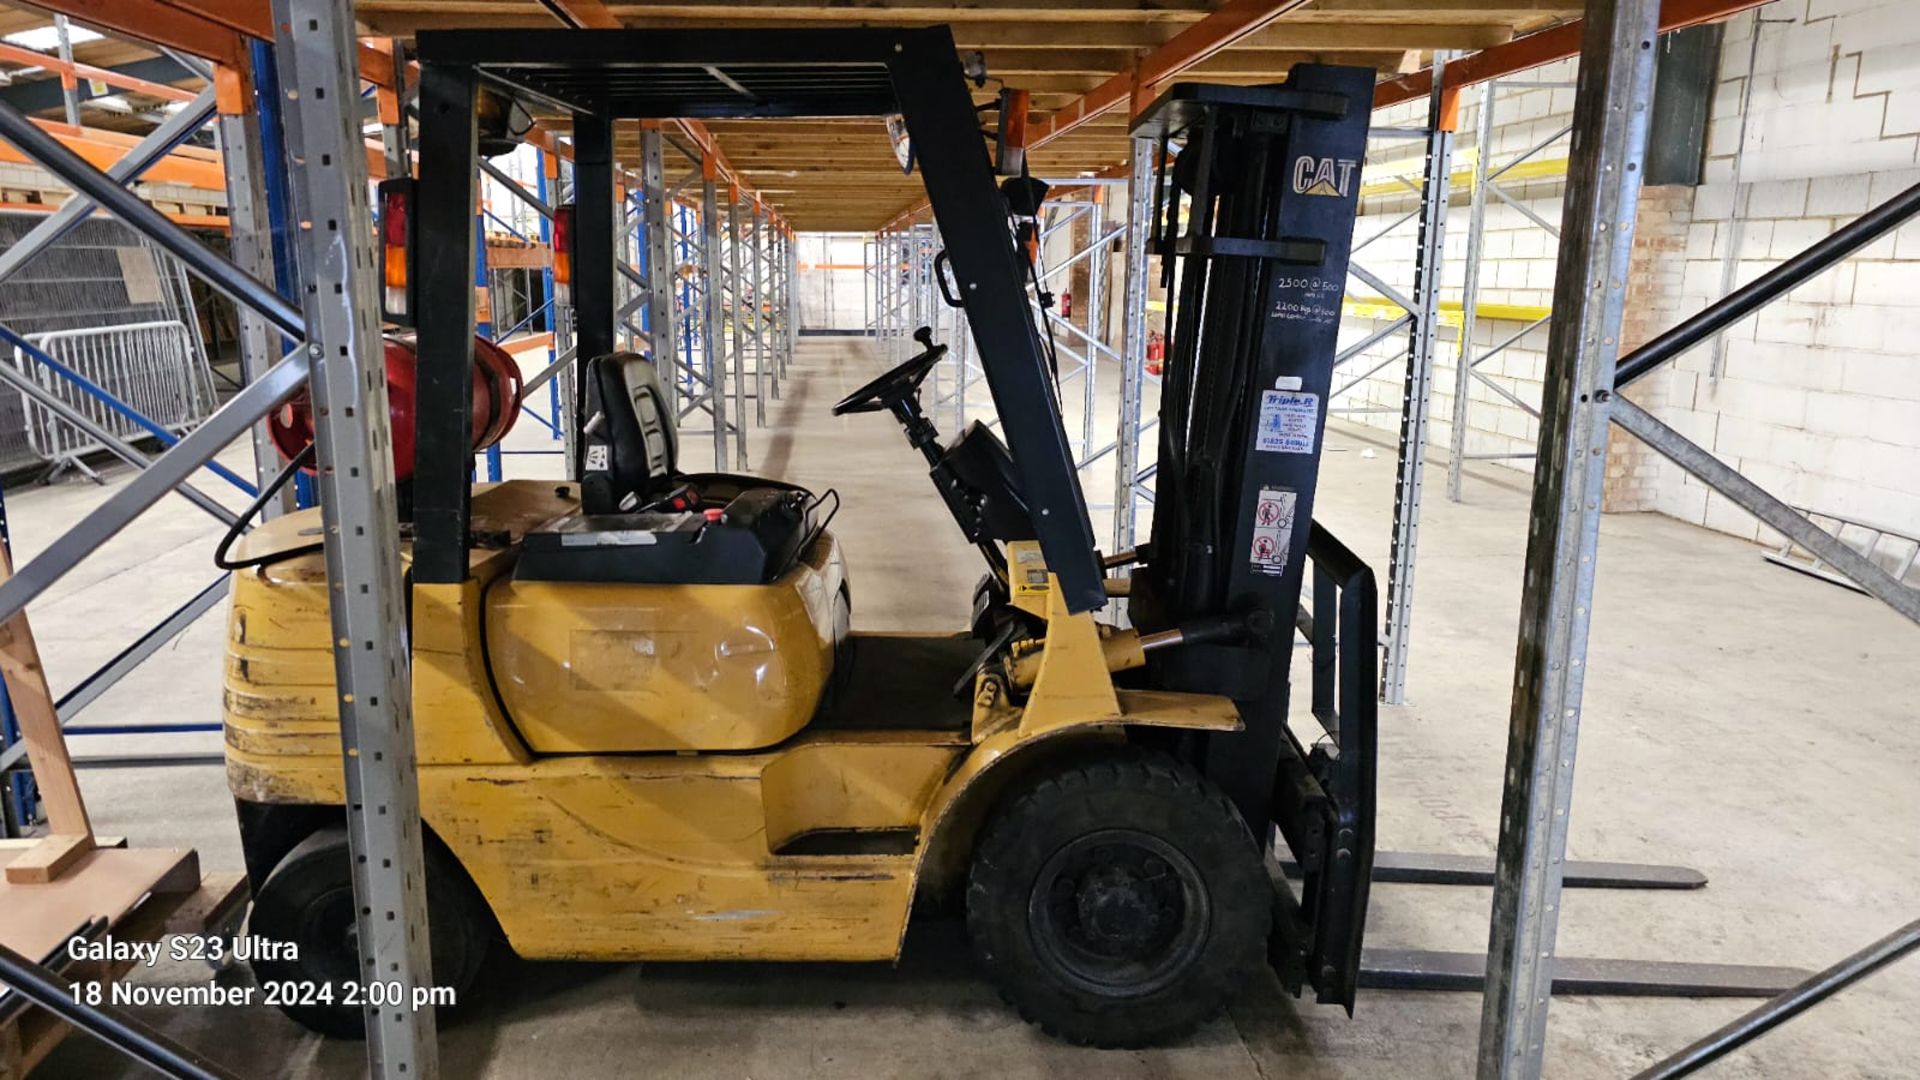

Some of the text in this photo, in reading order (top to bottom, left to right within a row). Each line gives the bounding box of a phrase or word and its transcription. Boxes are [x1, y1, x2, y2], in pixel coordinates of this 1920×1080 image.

[1293, 156, 1357, 197] CAT
[1278, 276, 1339, 291] 2500 @ 500
[1275, 300, 1299, 312] 2200
